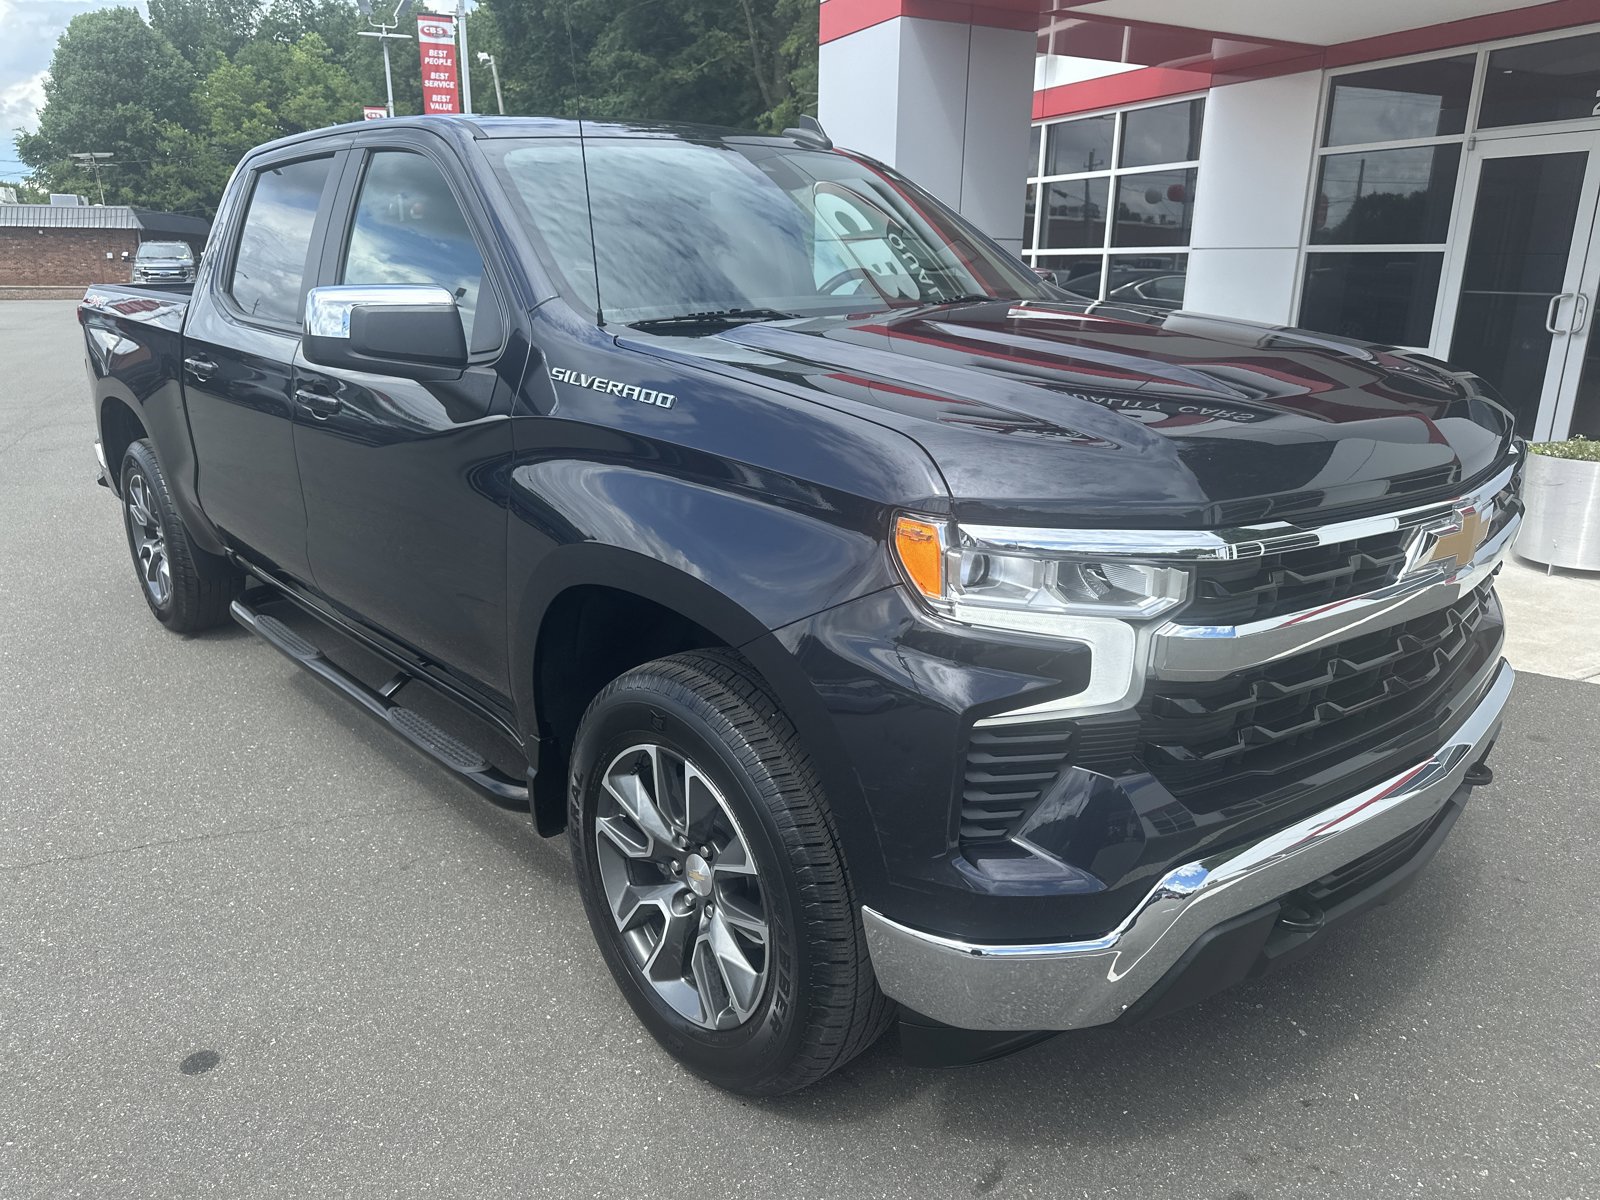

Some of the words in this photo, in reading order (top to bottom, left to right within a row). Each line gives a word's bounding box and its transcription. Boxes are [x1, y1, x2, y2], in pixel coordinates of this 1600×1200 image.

[423, 26, 443, 34] CBS
[428, 49, 447, 57] BEST
[424, 57, 452, 66] PEOPLE
[430, 72, 449, 80] BEST
[424, 80, 454, 89] SERVICE
[432, 94, 450, 102] BEST
[430, 102, 453, 111] VALUE
[550, 367, 677, 409] SILVERADO
